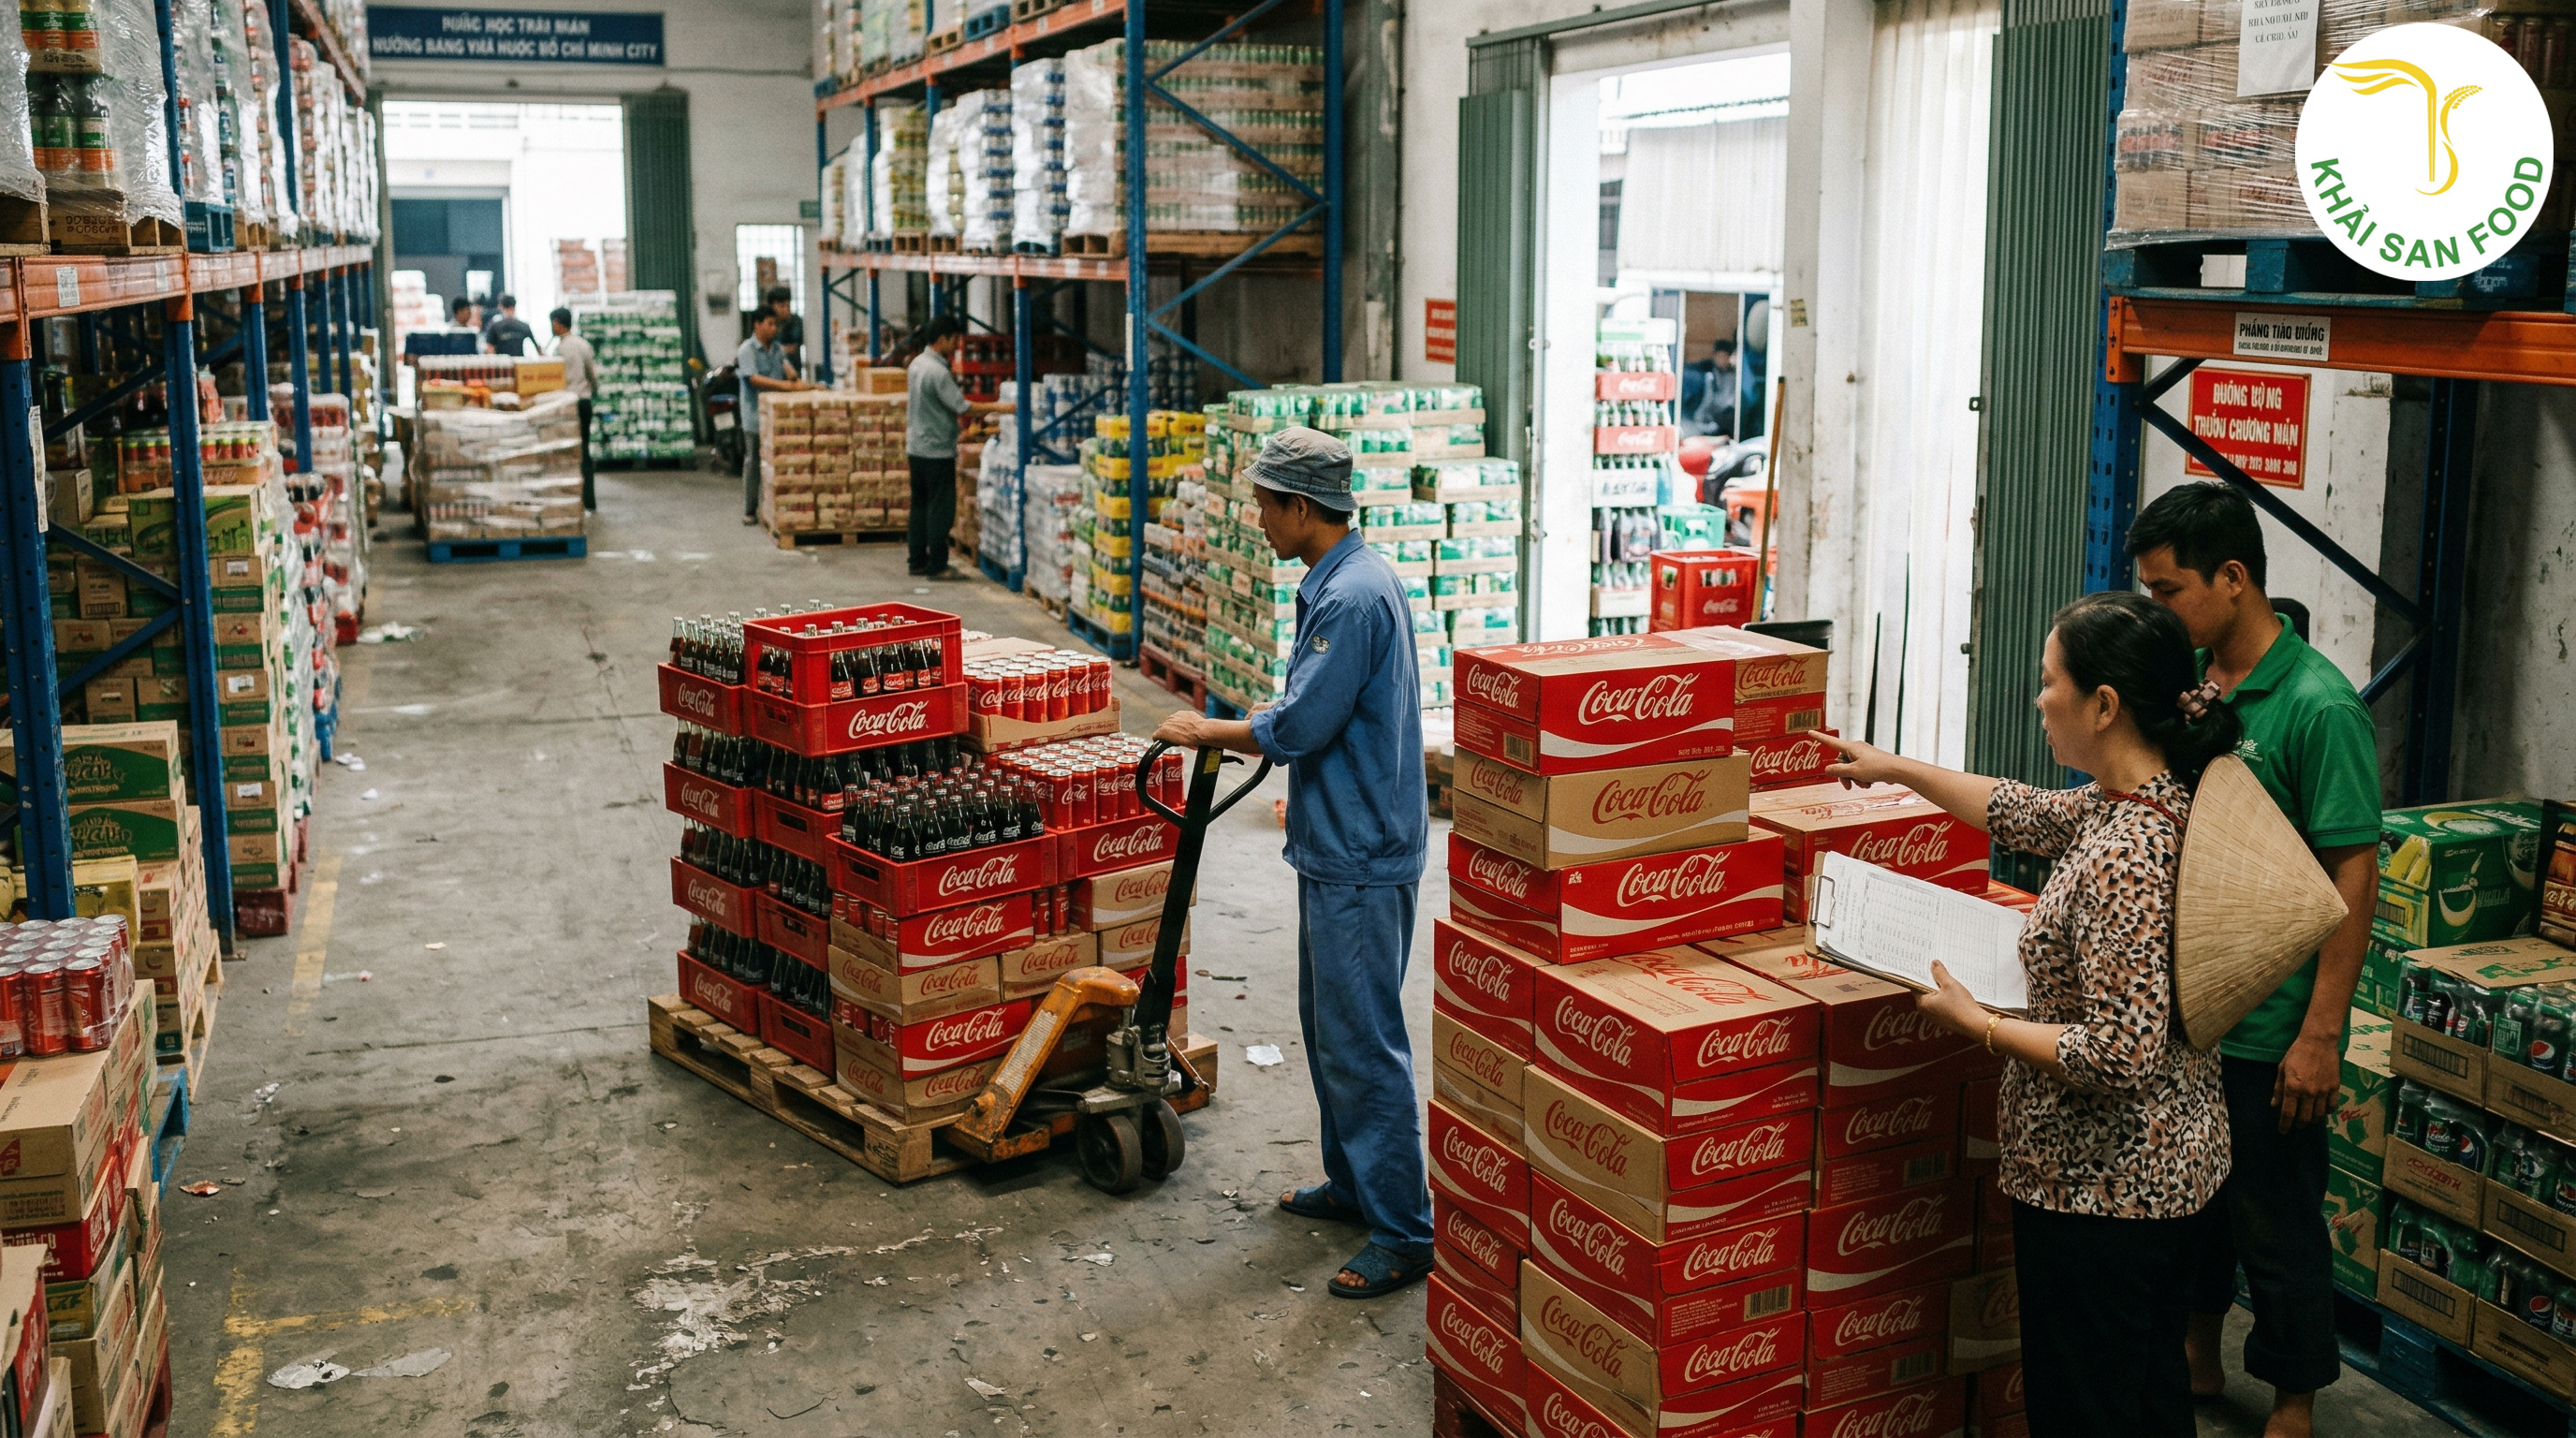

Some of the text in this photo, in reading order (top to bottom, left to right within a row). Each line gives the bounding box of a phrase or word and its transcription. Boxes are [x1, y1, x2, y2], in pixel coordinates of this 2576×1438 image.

[848, 700, 929, 740] Coca-Cola
[1577, 672, 1701, 726] Coca-Cola
[1591, 769, 1713, 825] Coca-Cola
[938, 853, 1019, 897] Coca-Cola
[1115, 870, 1172, 903] Coca-Col
[1617, 850, 1732, 907] Coca-Cola
[1697, 1015, 1796, 1068] Coca-Cola
[1691, 1122, 1791, 1176] Coca-Cola
